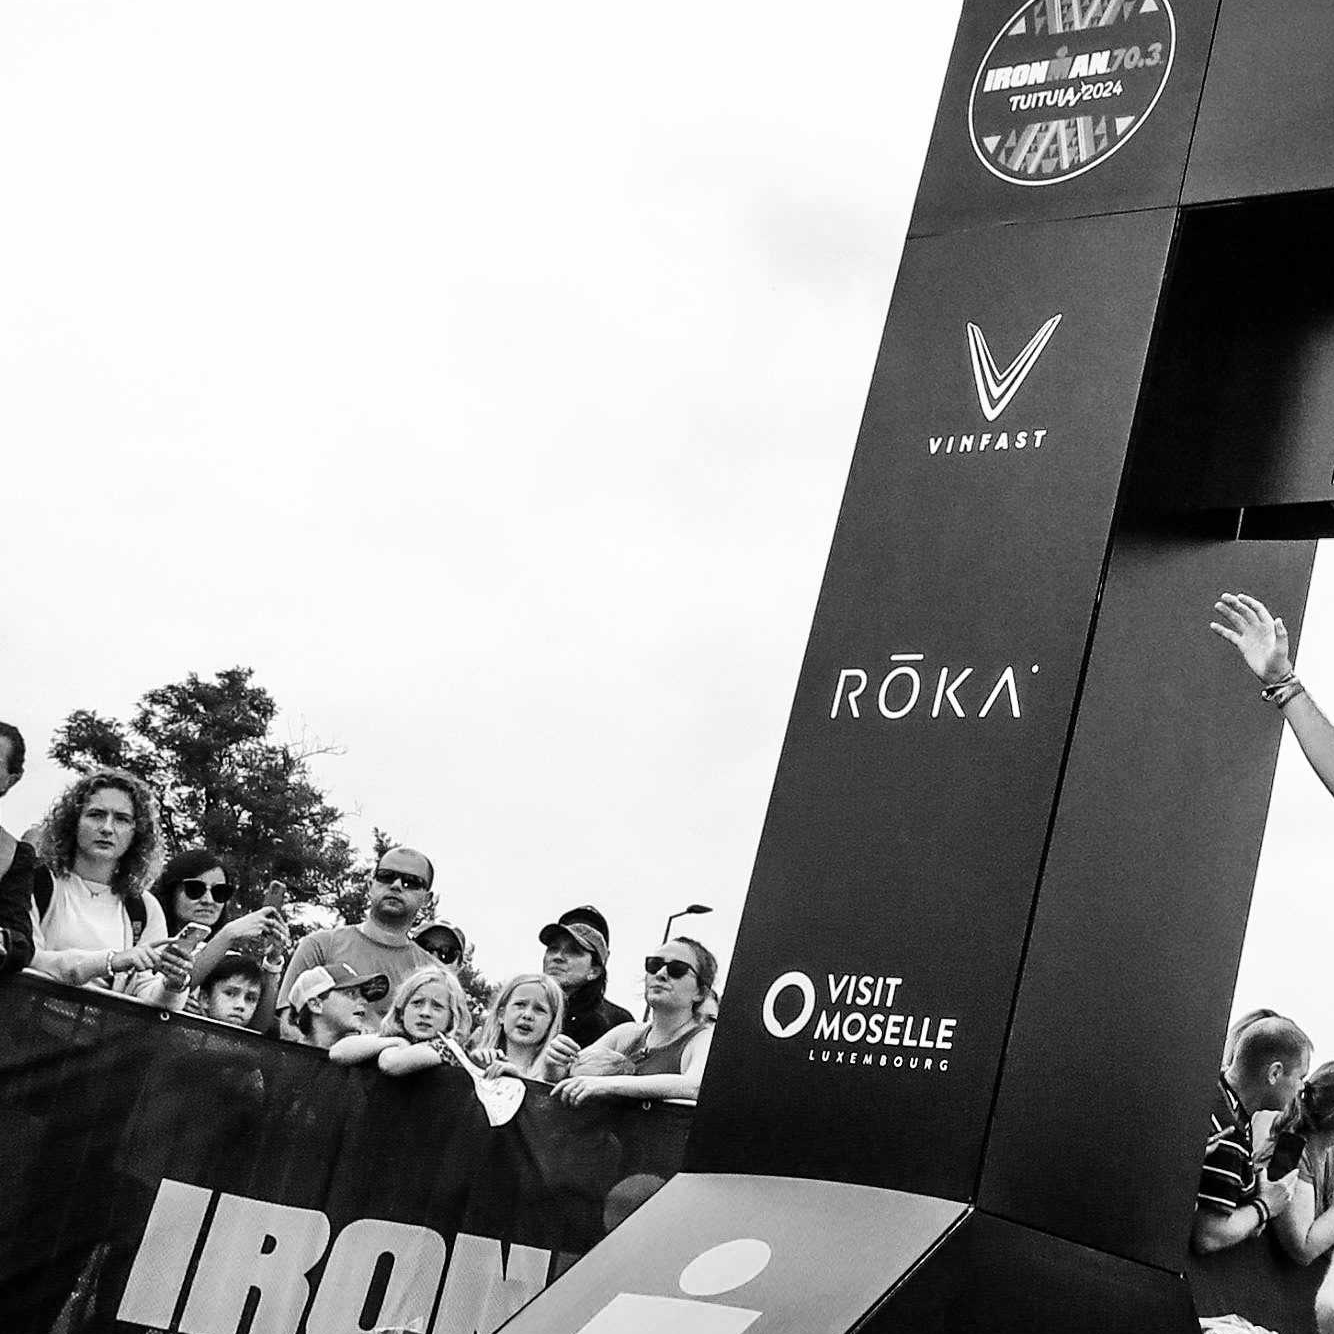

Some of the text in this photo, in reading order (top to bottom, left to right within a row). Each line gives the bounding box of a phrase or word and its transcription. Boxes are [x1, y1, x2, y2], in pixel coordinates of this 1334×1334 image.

[983, 42, 1163, 92] IRONMAN 70.3
[1083, 79, 1124, 101] 2024
[929, 429, 1047, 455] VINFAST
[828, 973, 903, 1008] VISIT
[813, 1009, 957, 1050] MOSELLE
[808, 1049, 949, 1071] LUXEMBOURG
